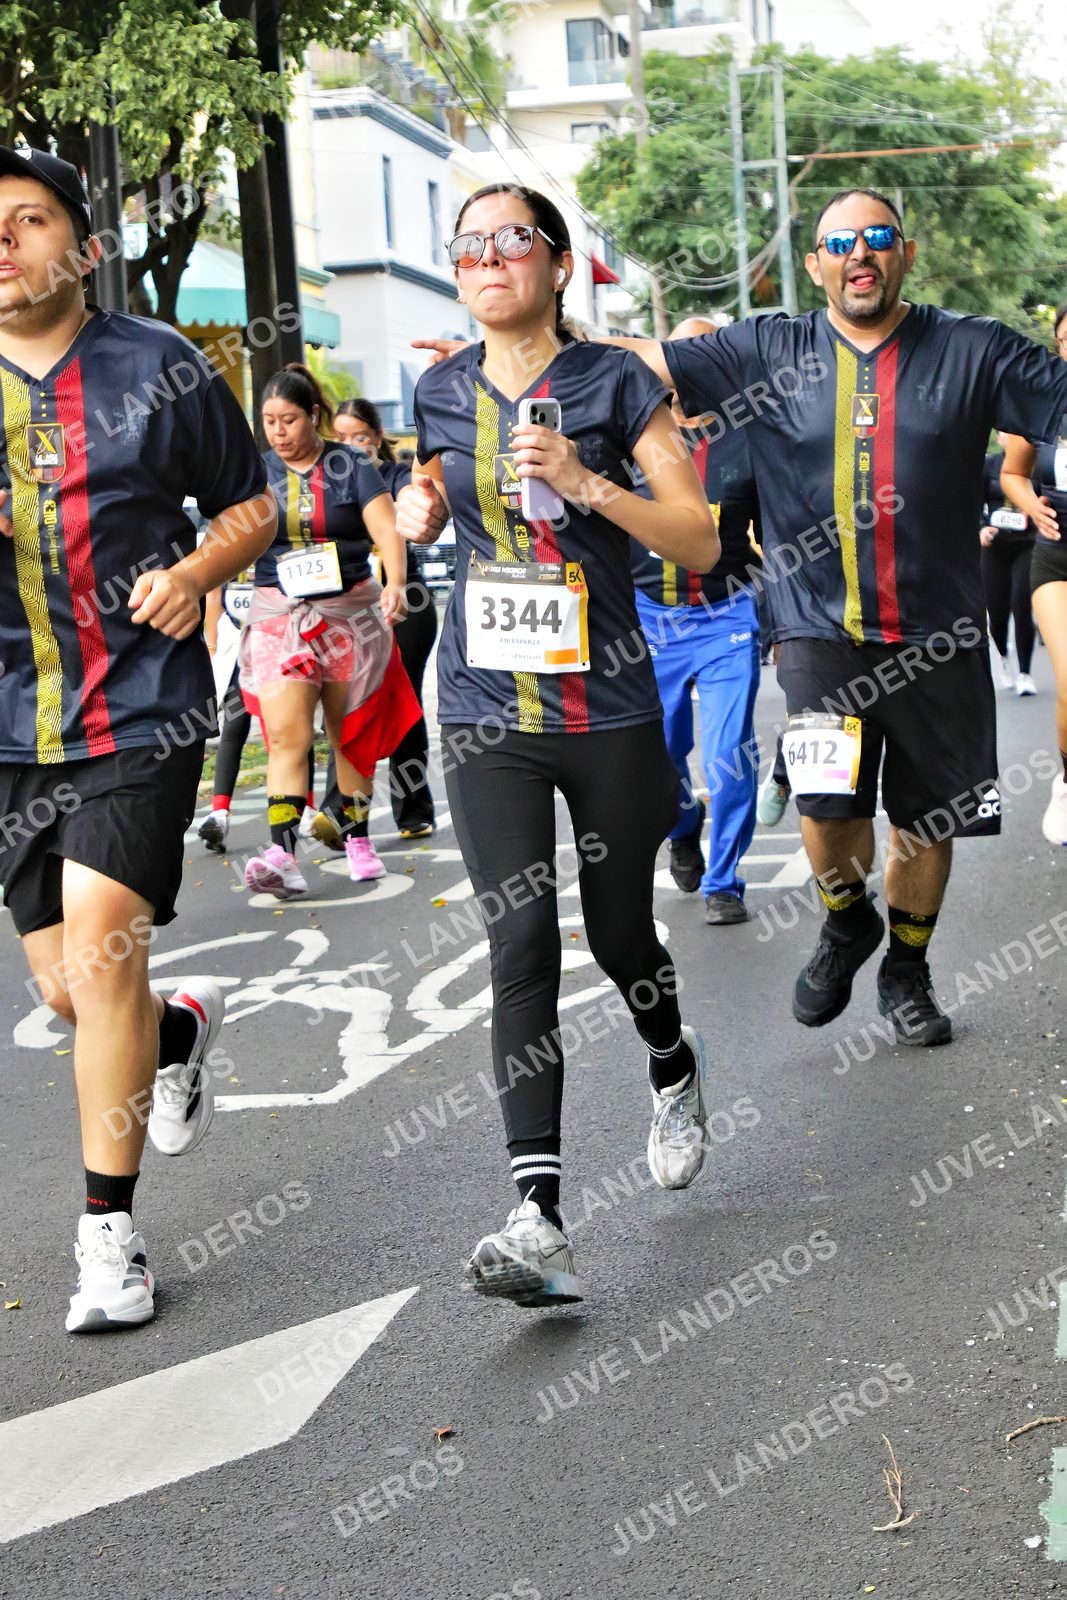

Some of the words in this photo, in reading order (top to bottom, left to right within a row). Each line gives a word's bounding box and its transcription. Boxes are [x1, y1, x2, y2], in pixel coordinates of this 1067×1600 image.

[287, 560, 324, 580] 1125
[481, 596, 562, 633] 3344
[789, 740, 837, 766] 6412
